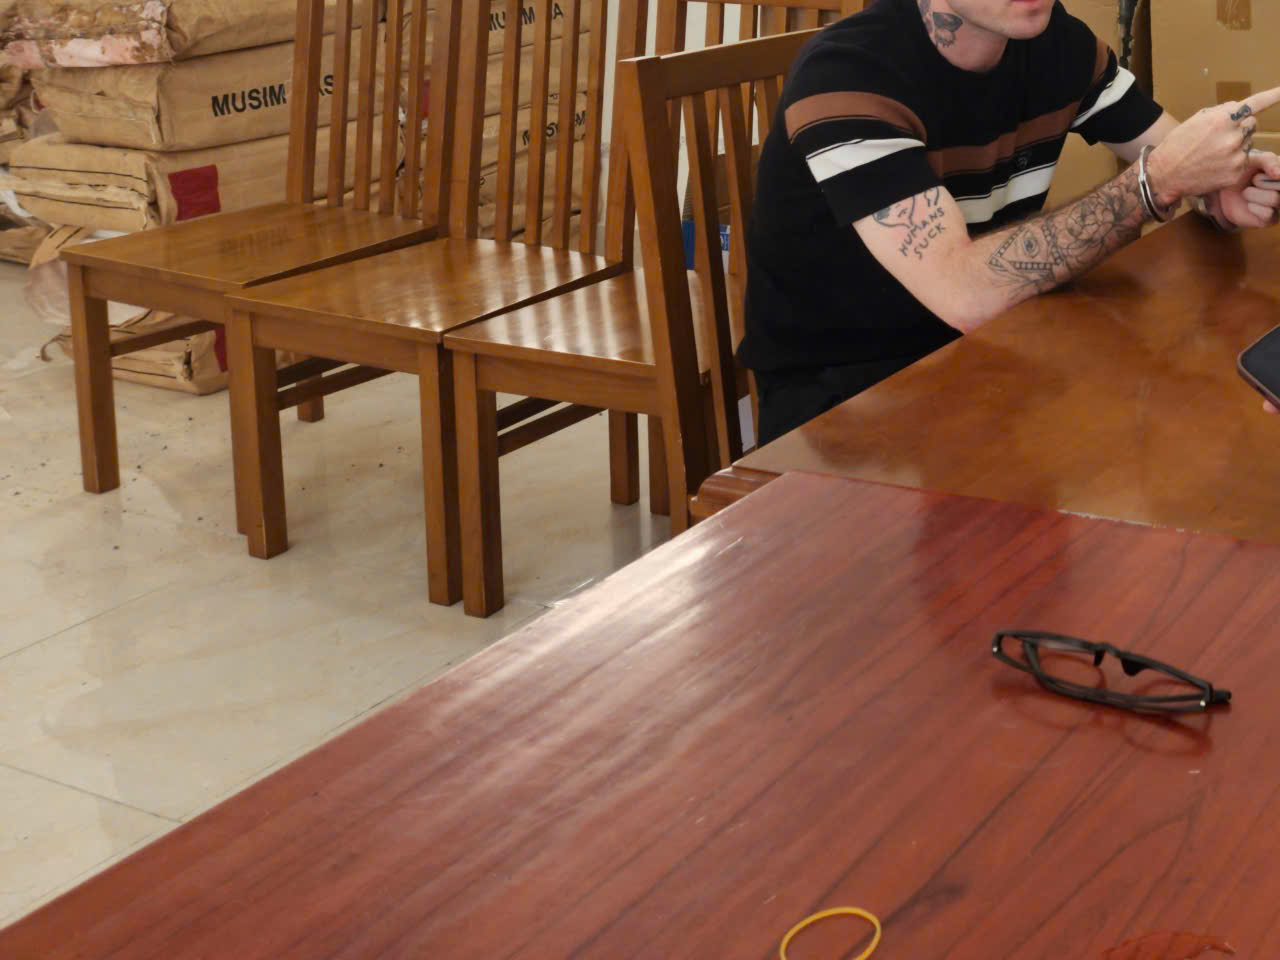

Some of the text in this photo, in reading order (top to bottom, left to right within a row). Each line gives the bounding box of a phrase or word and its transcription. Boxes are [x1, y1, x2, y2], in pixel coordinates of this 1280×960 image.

[211, 84, 287, 117] MUSIM
[899, 207, 945, 257] HUMANS
[913, 222, 946, 261] SUCK
